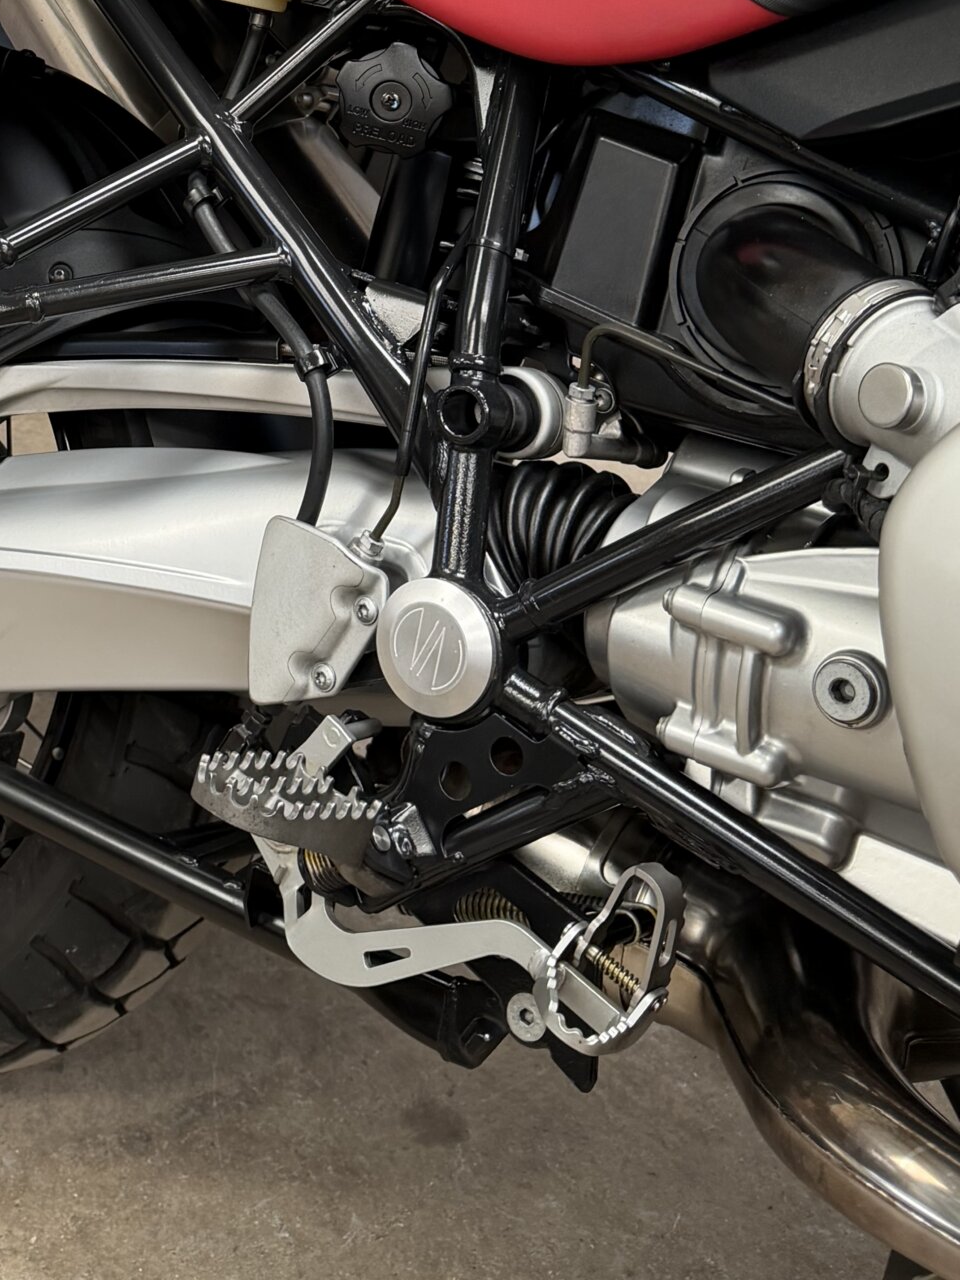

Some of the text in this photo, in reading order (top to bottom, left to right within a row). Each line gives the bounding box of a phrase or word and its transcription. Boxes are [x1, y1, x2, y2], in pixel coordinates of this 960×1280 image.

[346, 104, 369, 118] LOW
[401, 118, 427, 133] HIGH
[351, 121, 417, 148] PRELOAD
